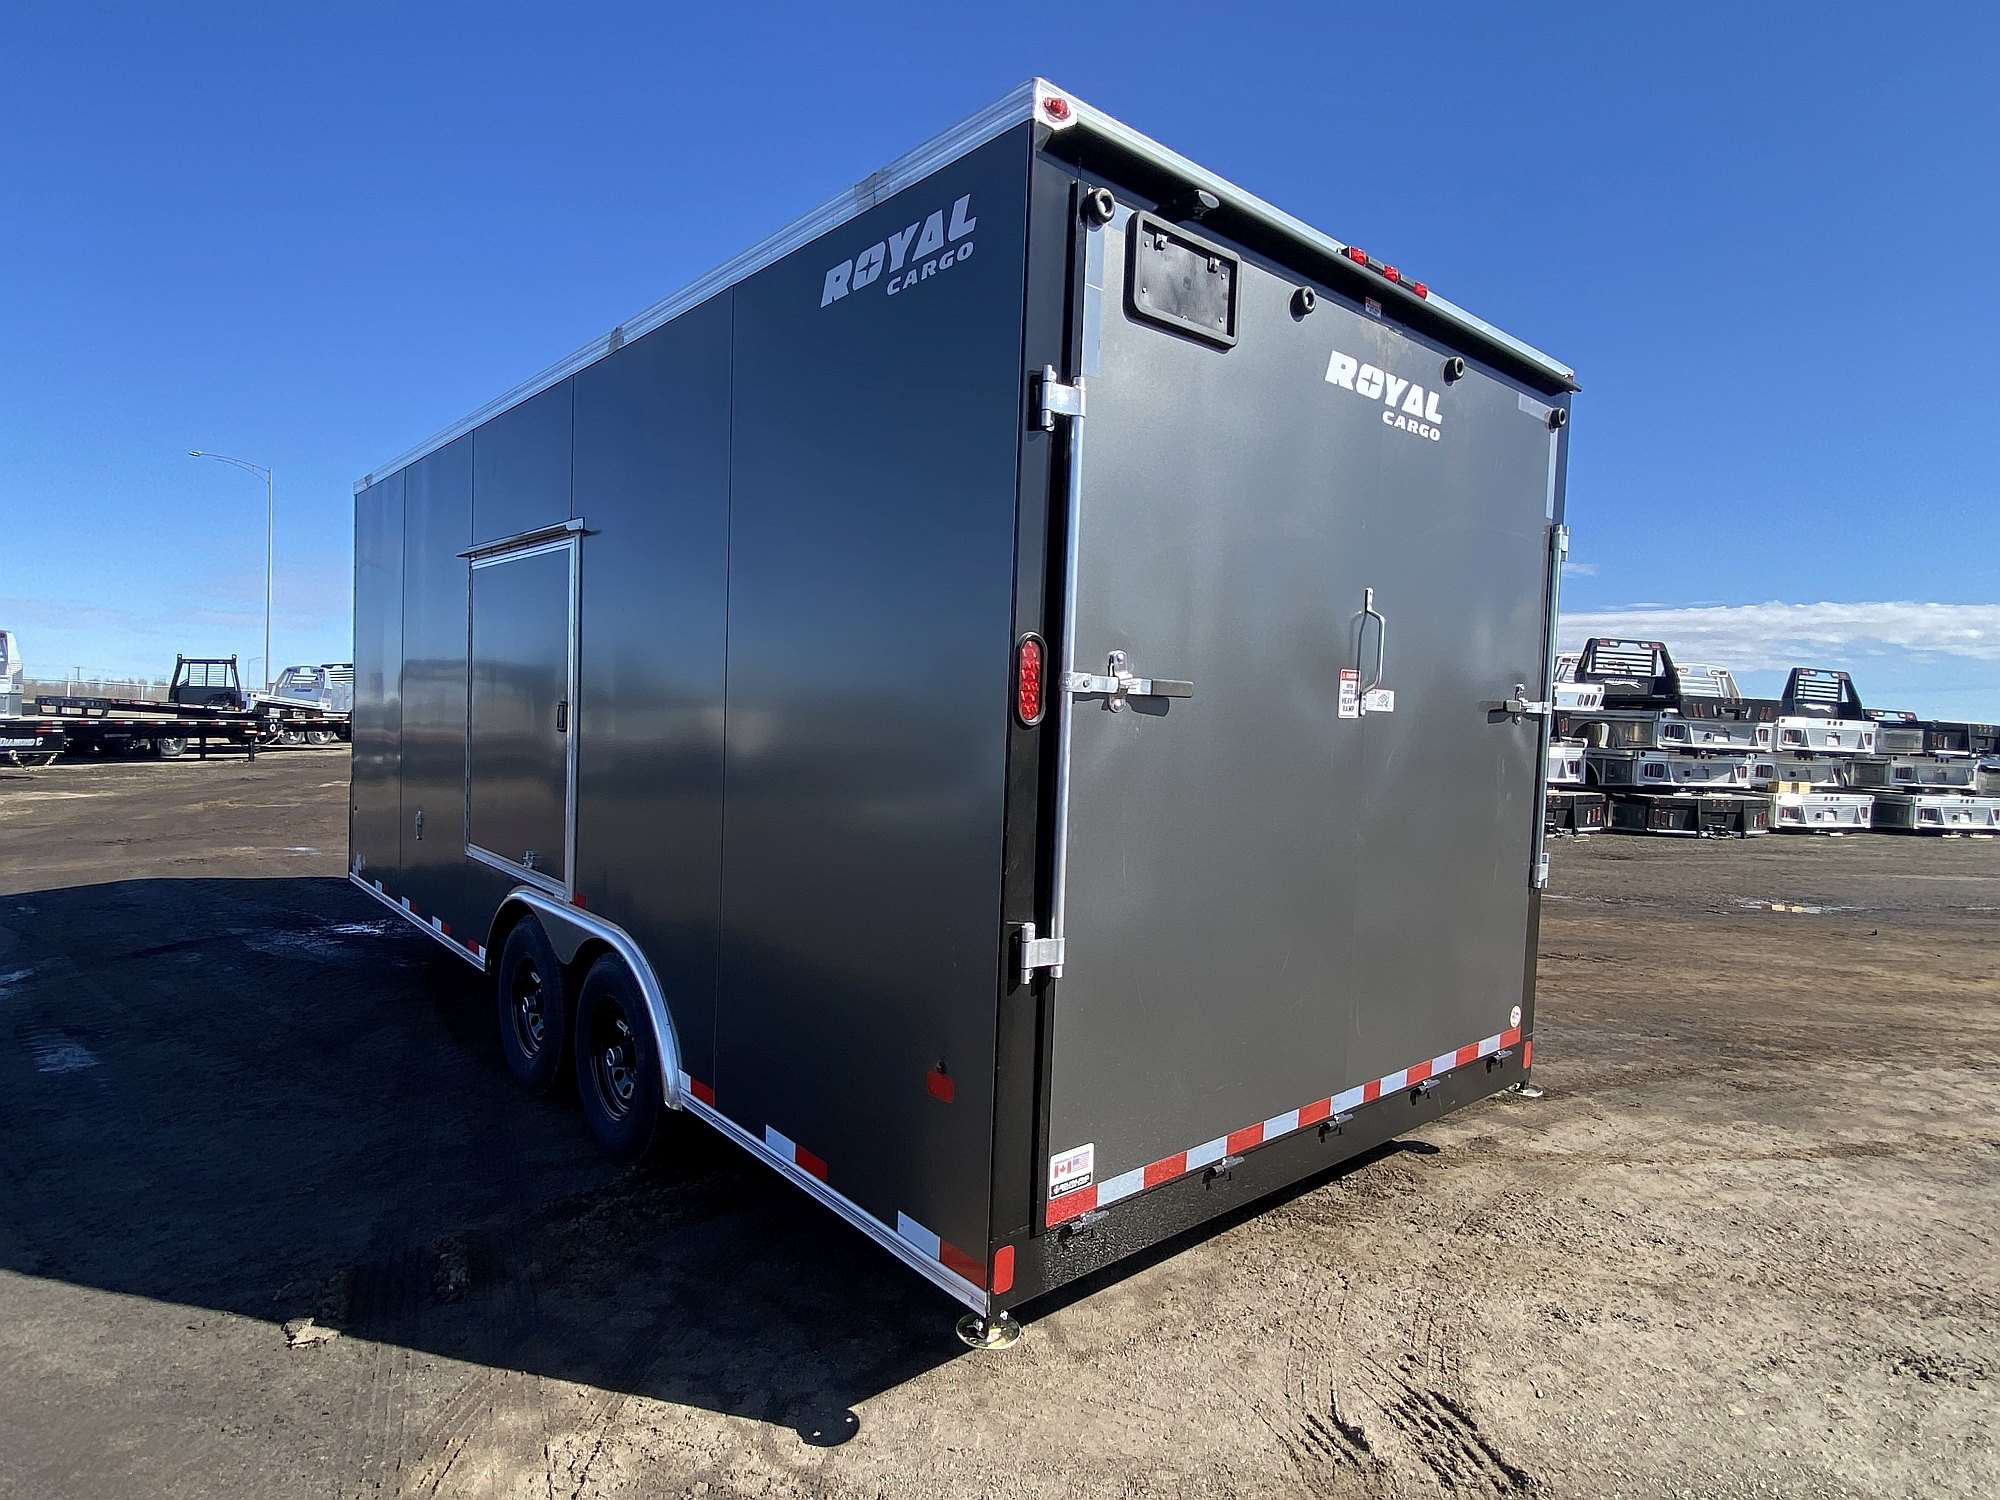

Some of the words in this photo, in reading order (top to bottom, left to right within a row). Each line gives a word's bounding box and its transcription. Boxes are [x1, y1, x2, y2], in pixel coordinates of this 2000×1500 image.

[820, 193, 977, 308] ROYAL
[886, 241, 974, 295] CARGO
[1325, 350, 1443, 424] ROYAL
[1382, 410, 1441, 441] CARGO
[36, 736, 44, 747] C
